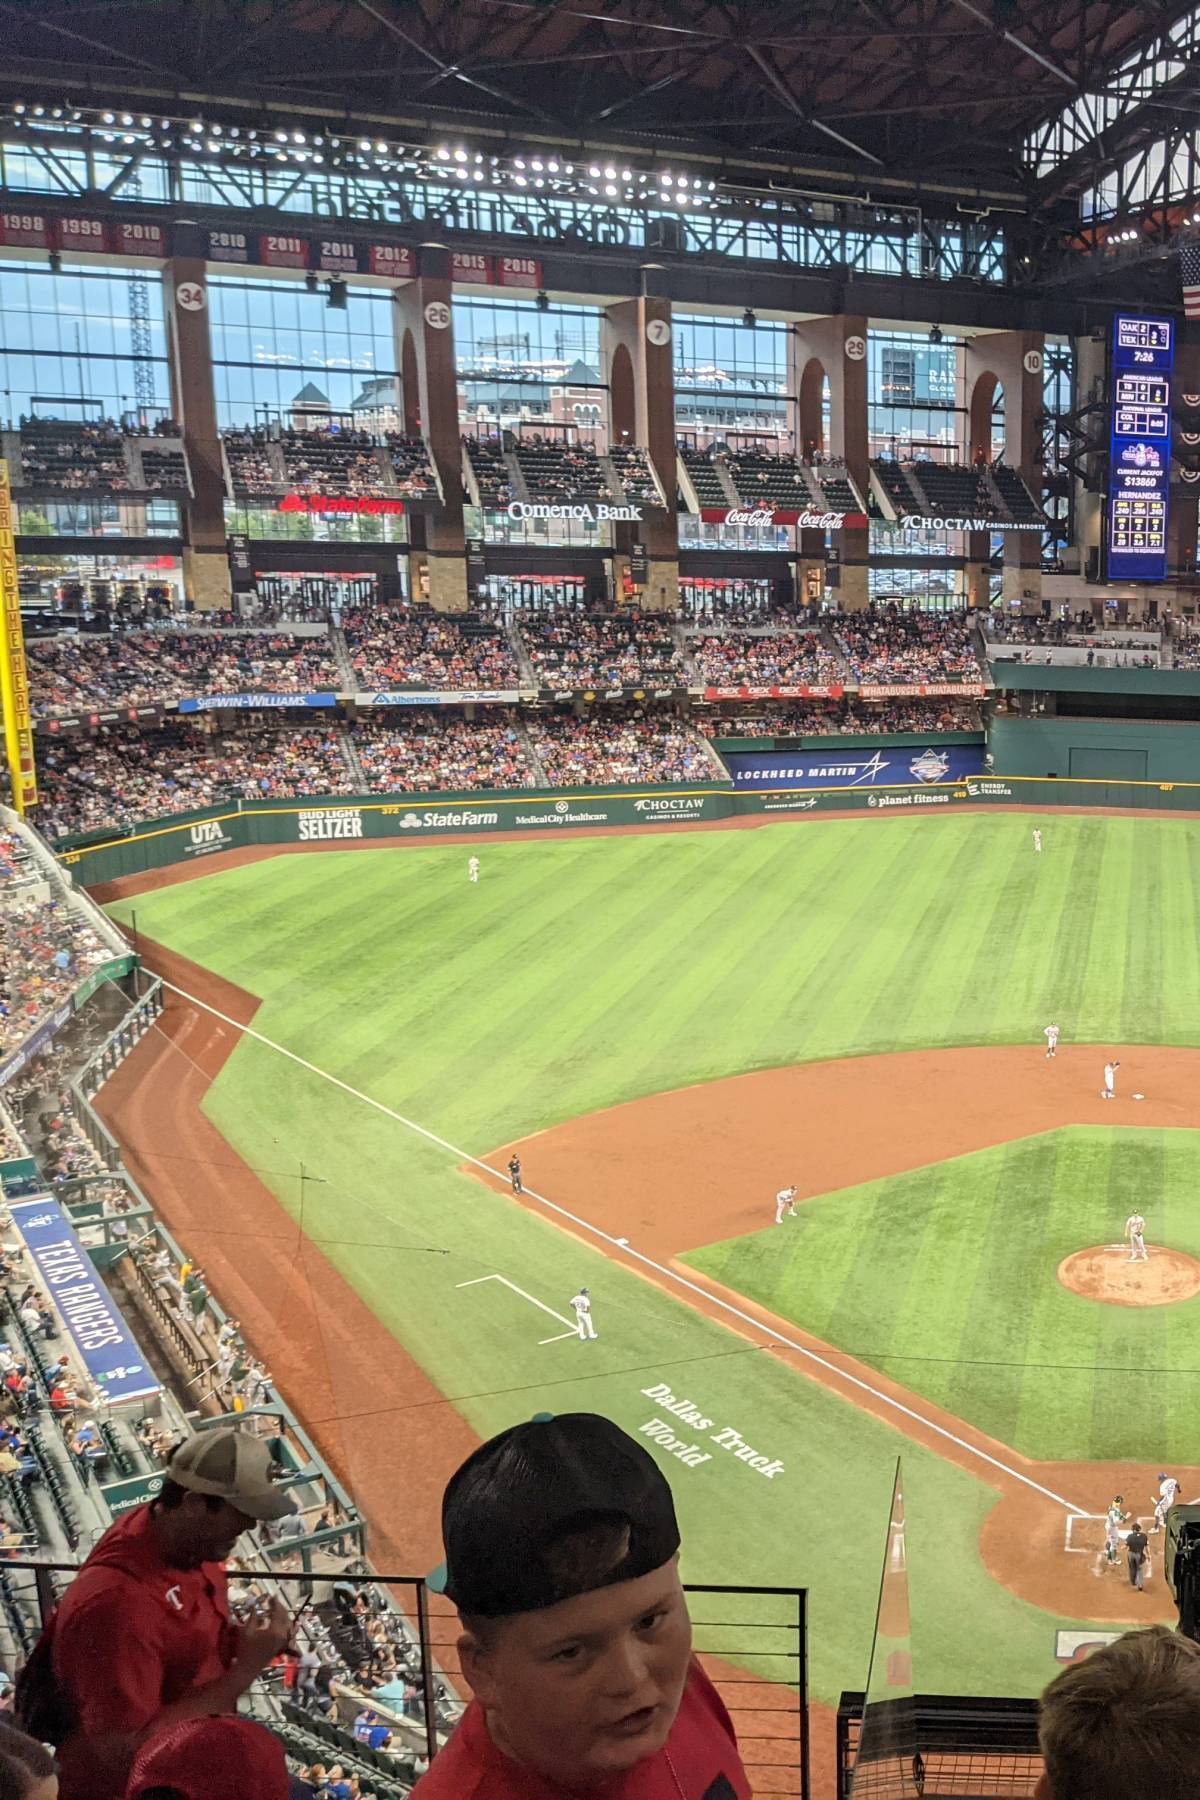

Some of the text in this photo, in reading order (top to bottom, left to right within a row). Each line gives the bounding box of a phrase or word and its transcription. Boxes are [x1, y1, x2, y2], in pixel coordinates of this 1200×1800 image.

[3, 214, 44, 231] 1998
[61, 219, 102, 235] 1999
[122, 224, 161, 240] 2010
[267, 236, 301, 252] 2011
[321, 242, 354, 258] 2011
[375, 246, 409, 262] 2012
[453, 253, 486, 269] 2015
[503, 258, 536, 274] 2016
[180, 288, 201, 304] 34
[428, 307, 448, 323] 26
[653, 325, 664, 340] 7
[1121, 323, 1147, 333] OAK 2
[1121, 335, 1137, 344] TEX
[848, 341, 864, 356] 29
[1134, 351, 1154, 362] 7:26
[1028, 354, 1040, 369] 10
[1117, 468, 1140, 476] CURRENT
[1124, 477, 1156, 487] $13860
[1118, 491, 1161, 500] HERNANDEZ
[597, 505, 643, 521] Bank
[725, 508, 775, 528] Coca-Cola
[797, 511, 844, 530] Coca-Cola
[909, 514, 986, 531] CHOCTAW
[861, 685, 982, 697] WHATABURGER WHATABURGER
[736, 766, 858, 781] LOCKHEED MARTIN
[980, 782, 1006, 791] ENERGY
[980, 788, 1012, 796] TRANSFER
[641, 798, 705, 811] CHOCTAW
[878, 792, 950, 808] planet fitness
[298, 809, 360, 820] BUD LIGHT
[515, 811, 609, 825] Medical City Healthcare
[190, 821, 226, 844] UTA
[298, 817, 364, 841] SELTZER
[33, 1239, 124, 1351] TEXAS RANGERS
[640, 1382, 785, 1479] Dallas Truck
[638, 1417, 713, 1468] World
